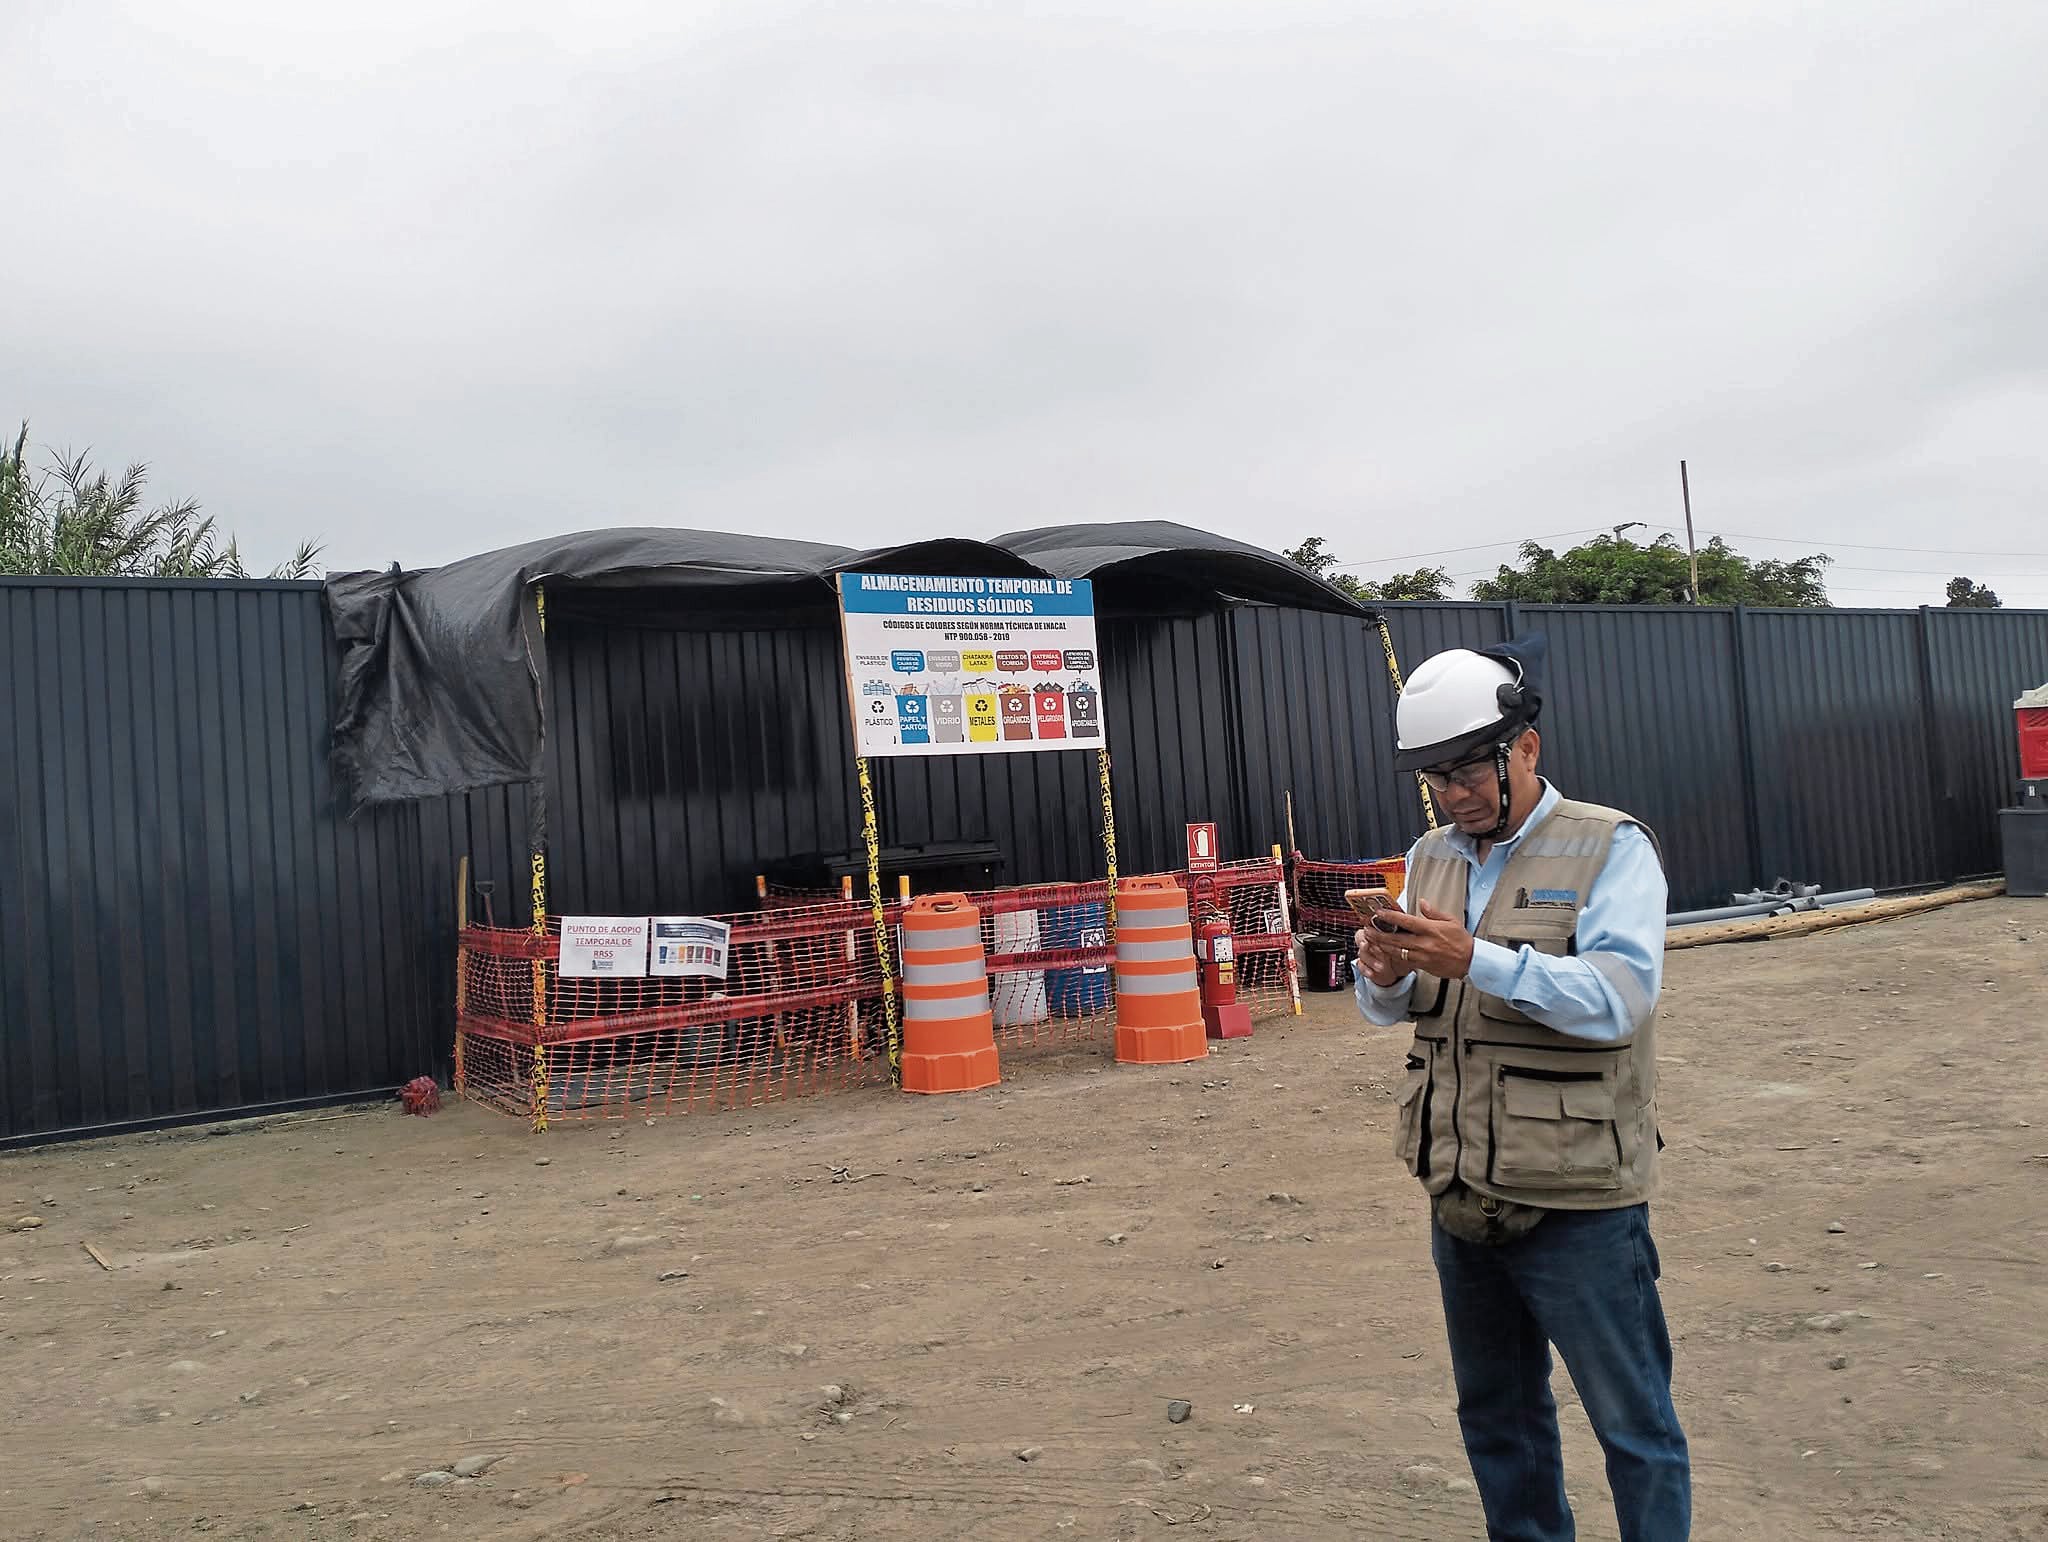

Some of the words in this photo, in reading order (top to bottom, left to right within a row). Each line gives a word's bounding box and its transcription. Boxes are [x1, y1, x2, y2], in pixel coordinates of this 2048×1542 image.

[861, 575, 984, 593] ALMACENAMIENTO
[987, 579, 1054, 594] TEMPORAL
[1056, 580, 1073, 595] DE
[907, 597, 975, 613] RESIDUOS
[977, 596, 1034, 613] SÓLIDOS
[883, 619, 914, 630] CÓDIGOS
[915, 621, 924, 630] DE
[925, 621, 956, 630] COLORES
[980, 622, 1004, 630] NORMA
[1005, 621, 1033, 630] TÉCNICA
[1034, 622, 1043, 630] DE
[944, 632, 957, 641] NTP
[958, 632, 988, 641] 900.058
[993, 632, 1010, 641] 2019
[935, 716, 961, 726] VIDRIO
[969, 716, 996, 727] METALES
[567, 925, 596, 934] PUNTO
[599, 925, 609, 934] DE
[611, 925, 642, 934] ACOPIO
[575, 937, 621, 946] TEMPORAL
[622, 937, 632, 946] DE
[593, 950, 614, 958] RRSS
